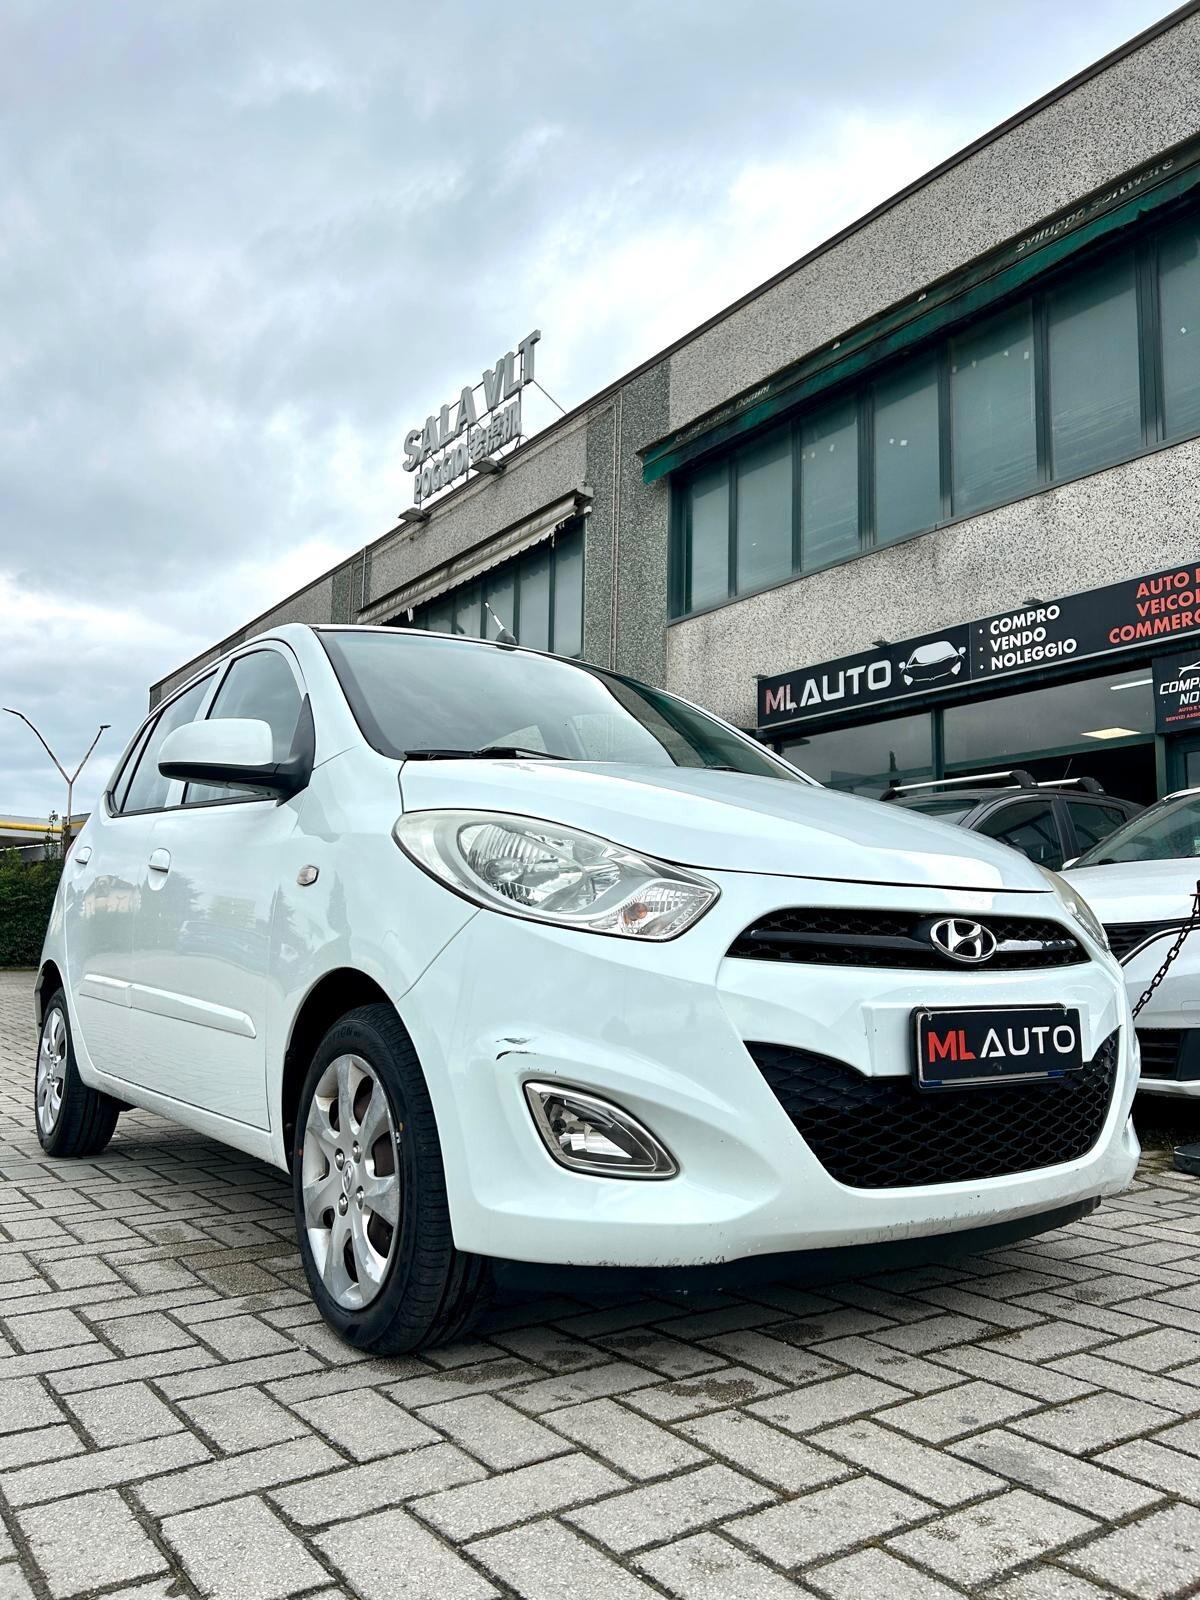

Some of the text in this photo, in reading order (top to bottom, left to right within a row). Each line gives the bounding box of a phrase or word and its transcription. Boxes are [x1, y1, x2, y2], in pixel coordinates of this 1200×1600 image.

[402, 329, 541, 472] SALA VLT
[414, 443, 469, 504] POGGIO
[1136, 572, 1190, 599] AUTO
[990, 605, 1060, 635] COMPRO
[990, 627, 1046, 652] VENDO
[991, 638, 1077, 671] NOLEGGIO
[765, 660, 892, 714] ML AUTO
[1160, 677, 1200, 695] COMP
[927, 1025, 1076, 1063] ML AUTO
